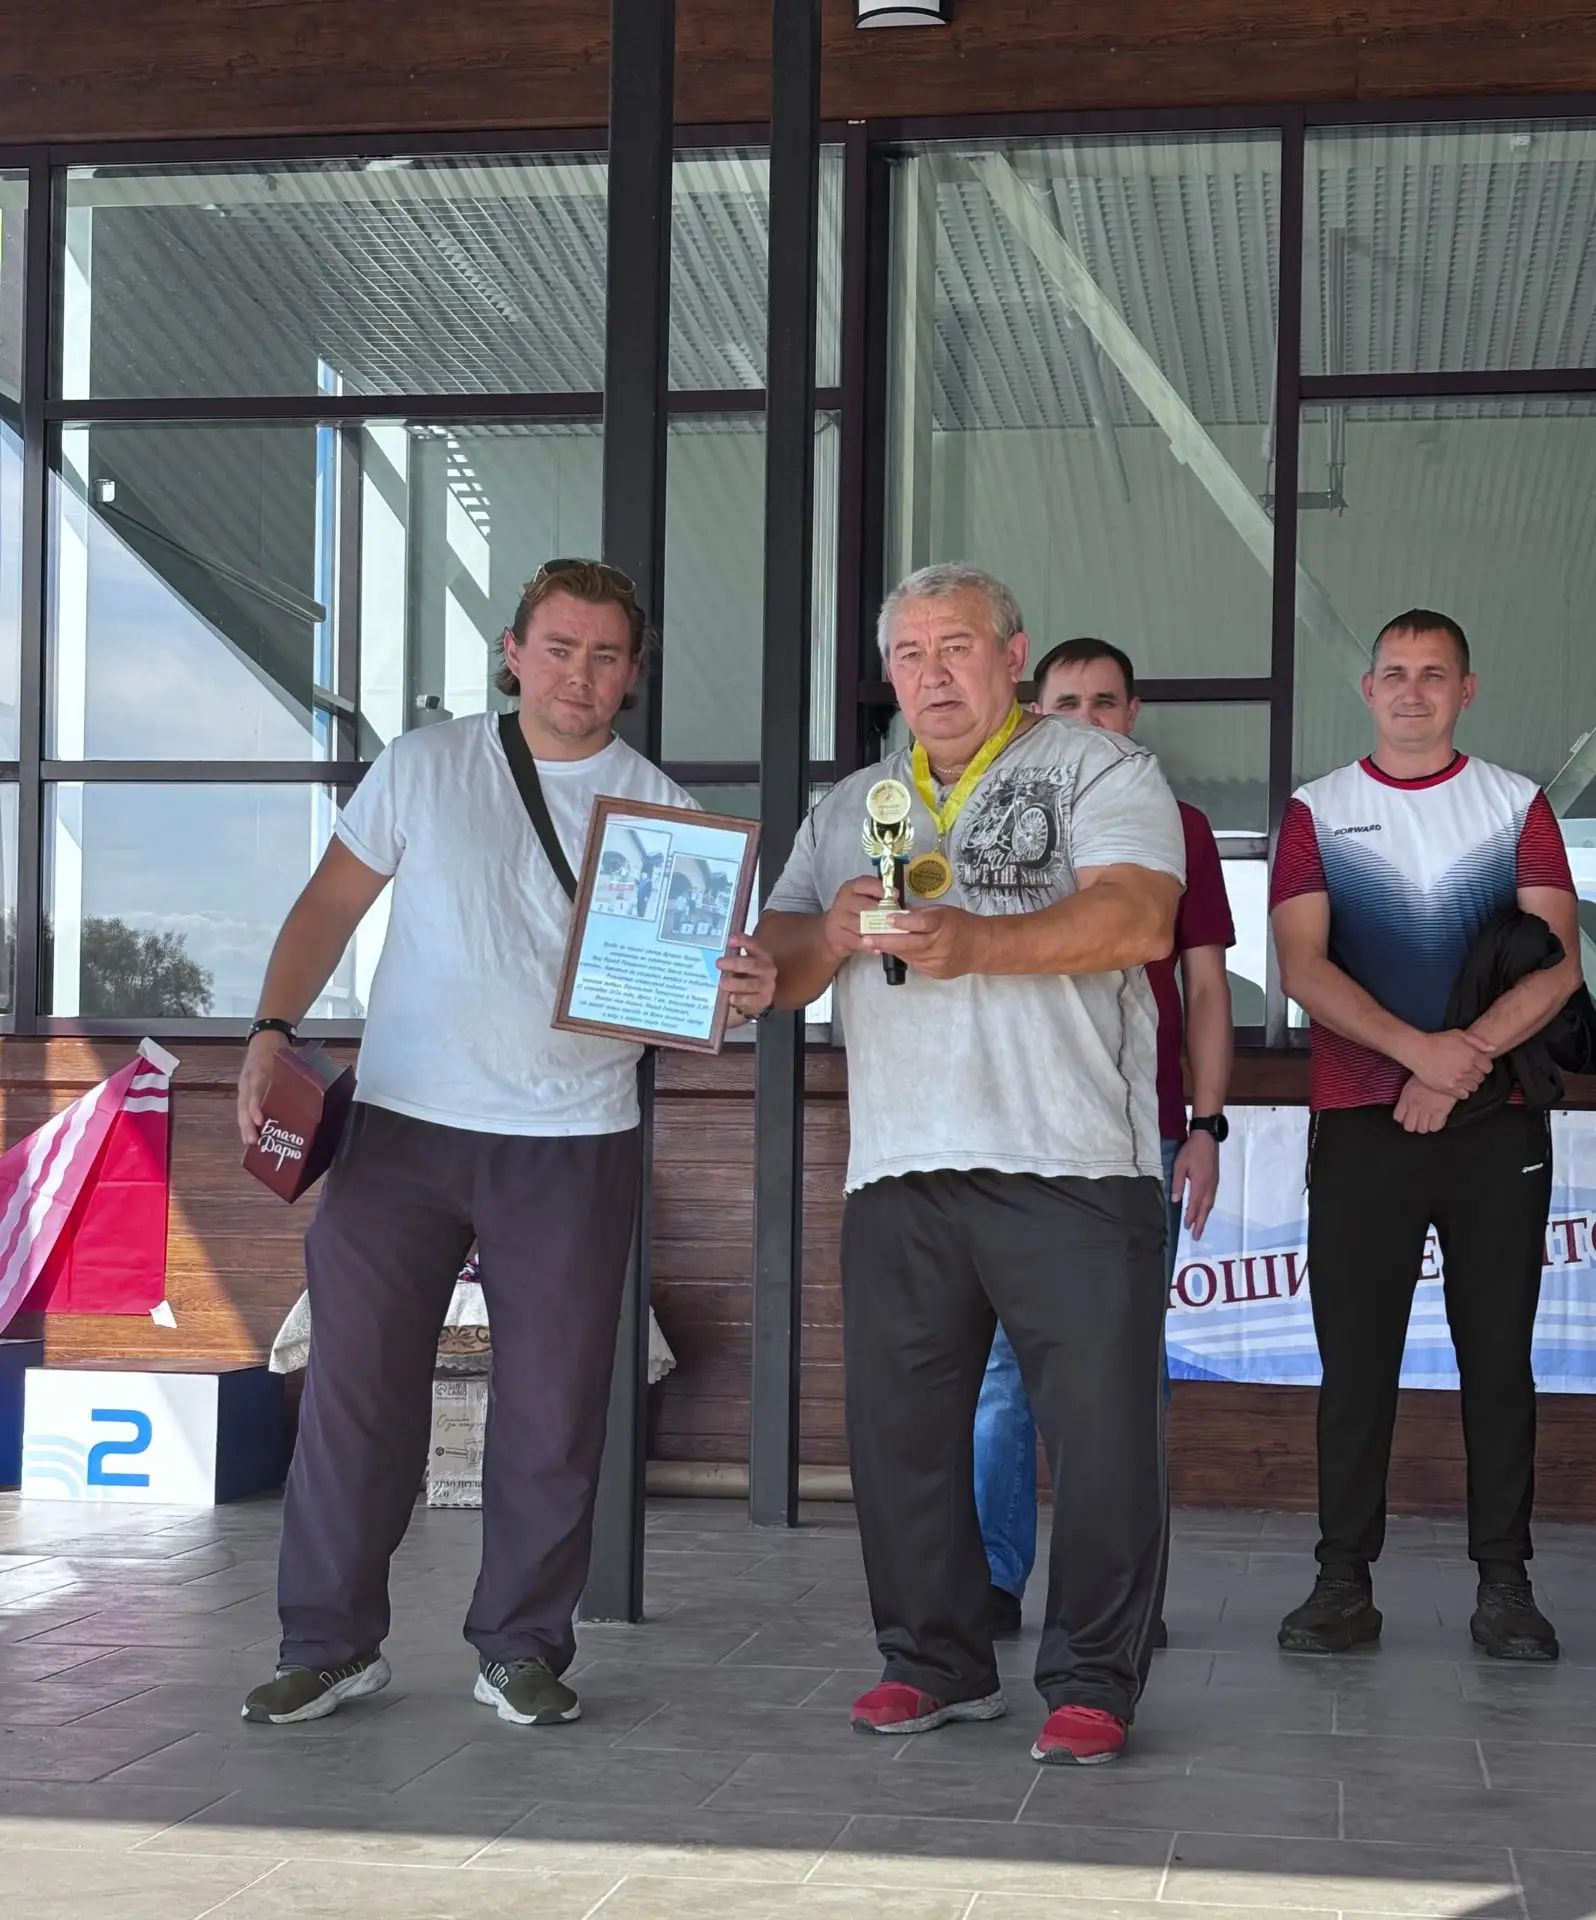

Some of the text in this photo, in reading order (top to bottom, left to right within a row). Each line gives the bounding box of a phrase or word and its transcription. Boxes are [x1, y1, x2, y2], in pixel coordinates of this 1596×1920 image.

[1334, 824, 1381, 836] FORWARD
[260, 1118, 305, 1146] Благо
[257, 1134, 303, 1172] Дарю
[87, 1408, 153, 1487] 2
